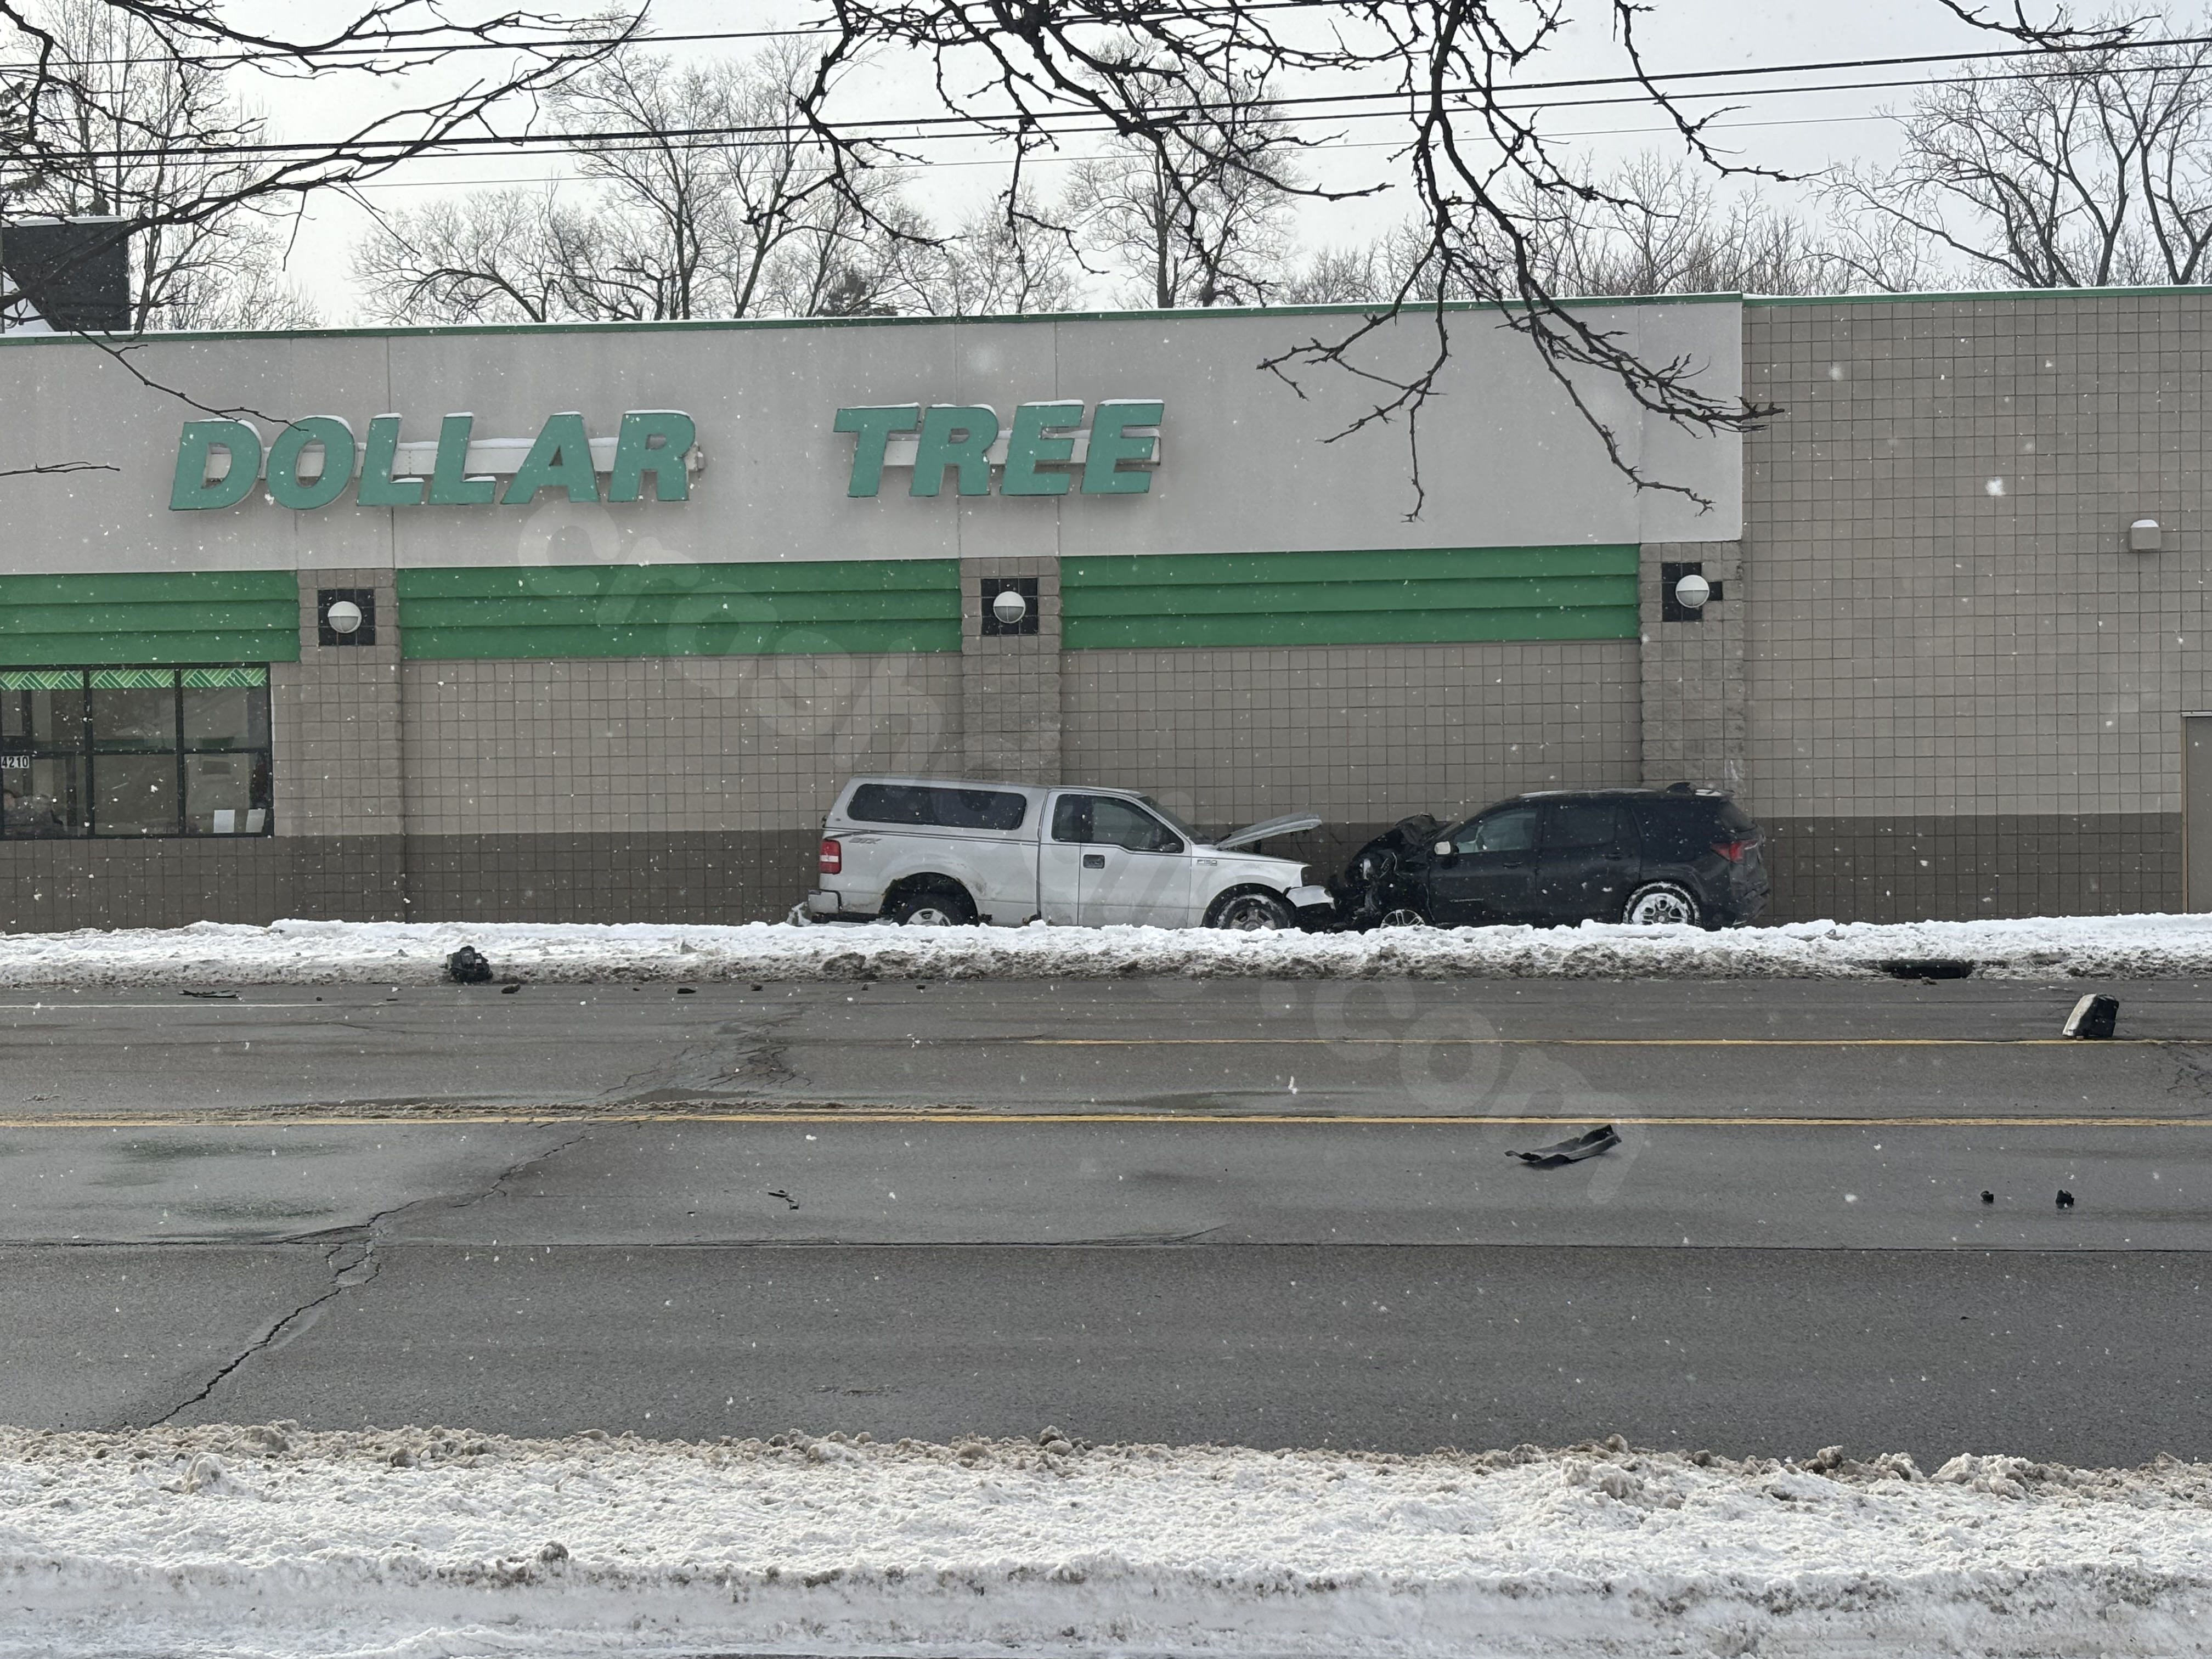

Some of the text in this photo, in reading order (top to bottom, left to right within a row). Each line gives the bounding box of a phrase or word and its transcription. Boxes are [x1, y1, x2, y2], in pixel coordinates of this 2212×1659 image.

[169, 402, 1165, 511] DOLLAR TREE
[2, 757, 28, 768] 4210
